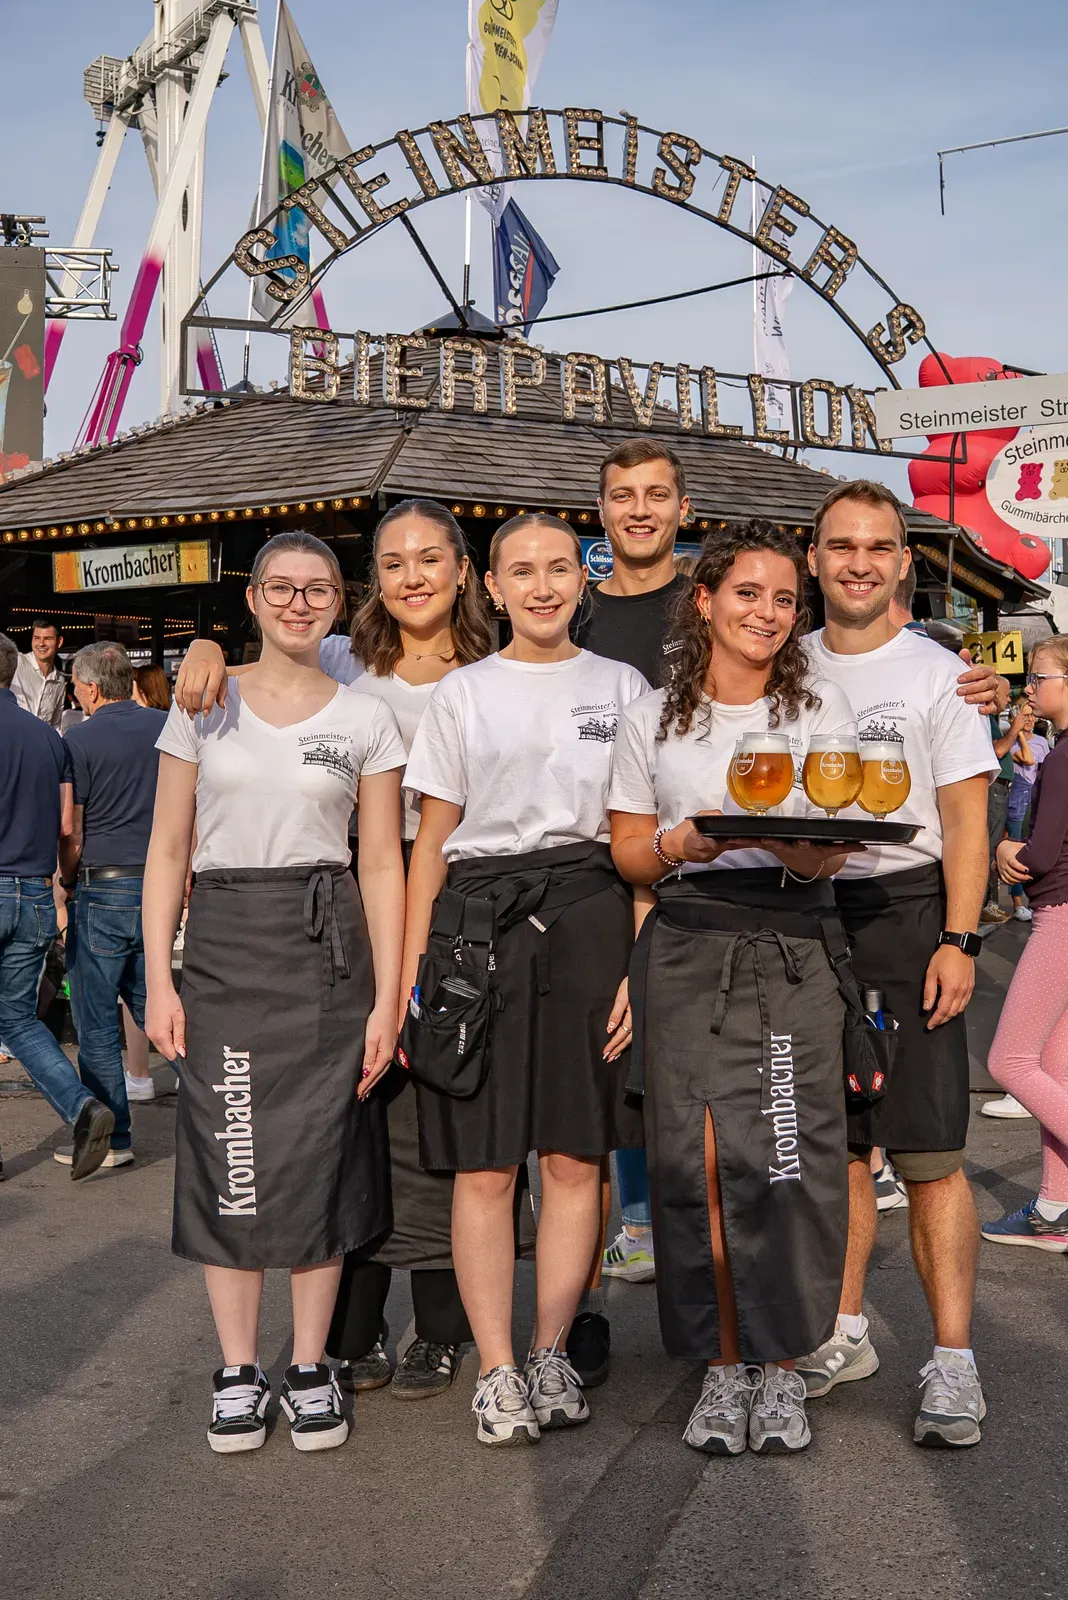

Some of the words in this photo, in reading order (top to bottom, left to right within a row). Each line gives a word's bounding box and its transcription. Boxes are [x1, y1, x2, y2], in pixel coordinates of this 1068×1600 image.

[289, 326, 893, 453] BIERPAVILLON
[899, 405, 1028, 431] Steinmeister
[1040, 398, 1068, 417] Str
[1004, 434, 1068, 466] Steinm
[1000, 500, 1068, 523] Gummibärche
[82, 549, 176, 588] Krombacher
[590, 554, 613, 564] Schlösse
[968, 640, 1018, 664] 214
[570, 701, 617, 715] Steinmeister's
[856, 699, 907, 718] Steinmeister's
[298, 731, 354, 745] Steinmeister's
[760, 1031, 801, 1185] Krombacher
[211, 1045, 257, 1216] Krombacher
